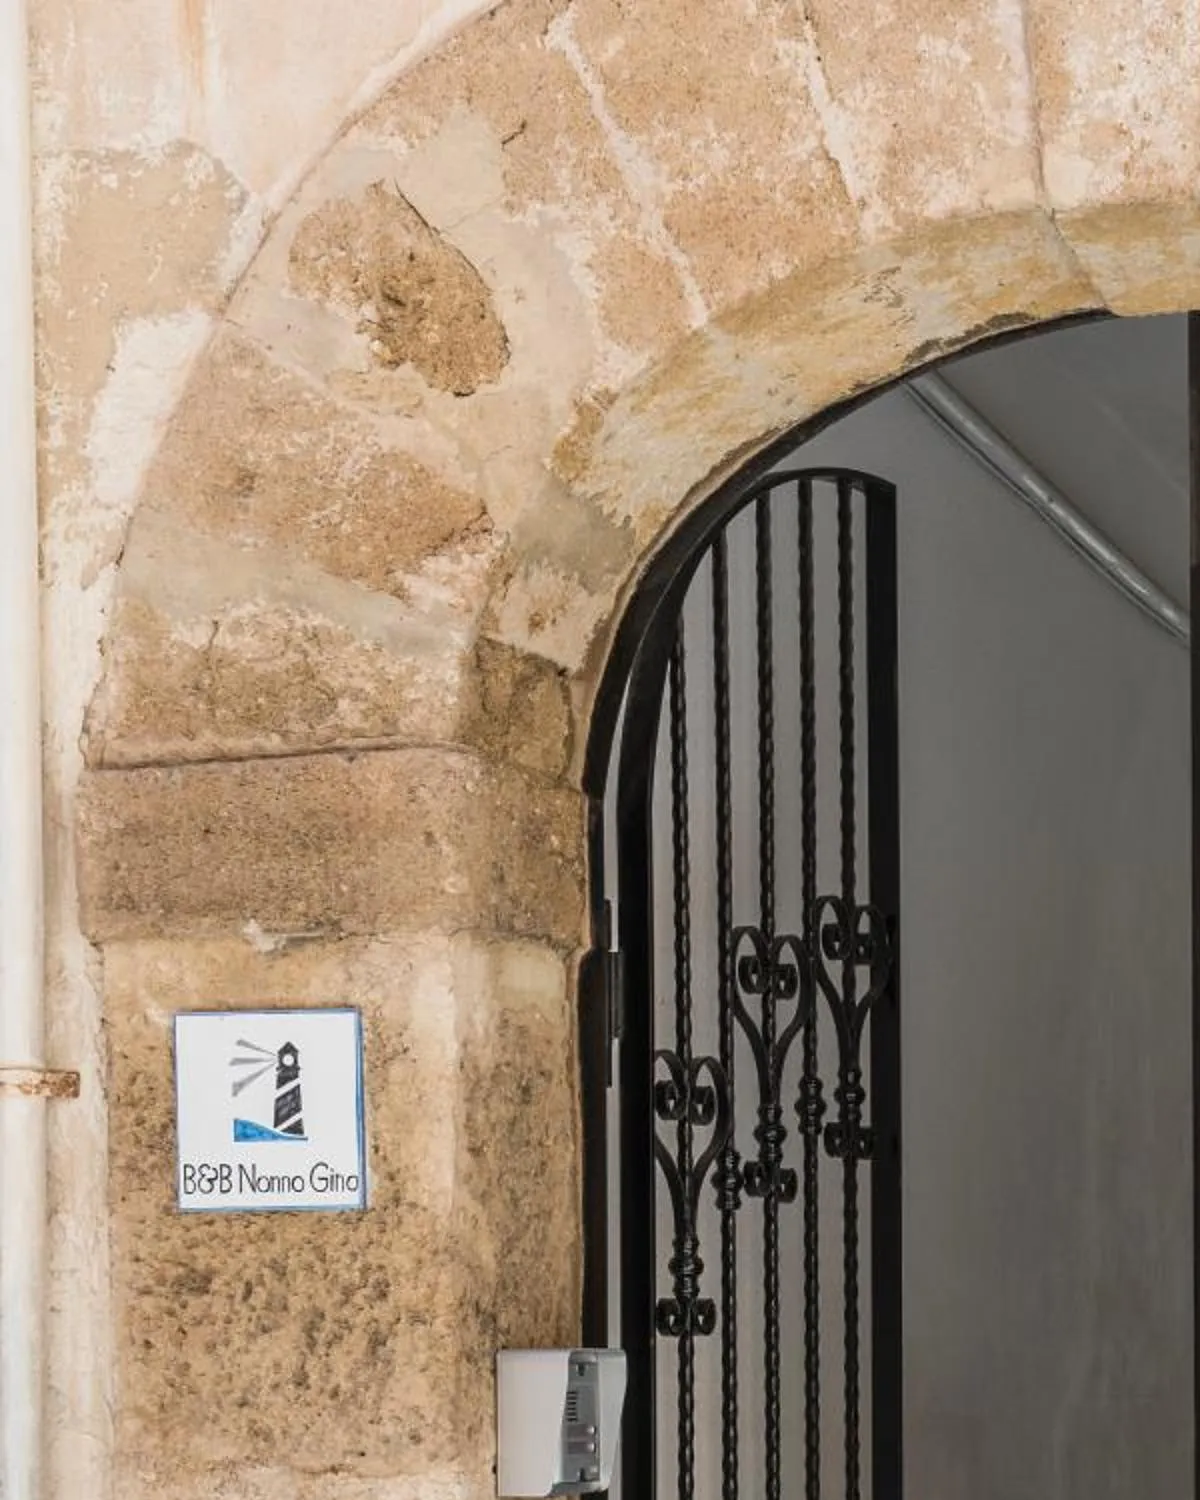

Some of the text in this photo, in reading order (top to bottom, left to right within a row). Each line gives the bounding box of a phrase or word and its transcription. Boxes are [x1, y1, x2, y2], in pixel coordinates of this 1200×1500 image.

[183, 1162, 359, 1194] B&B Nonno Gino
